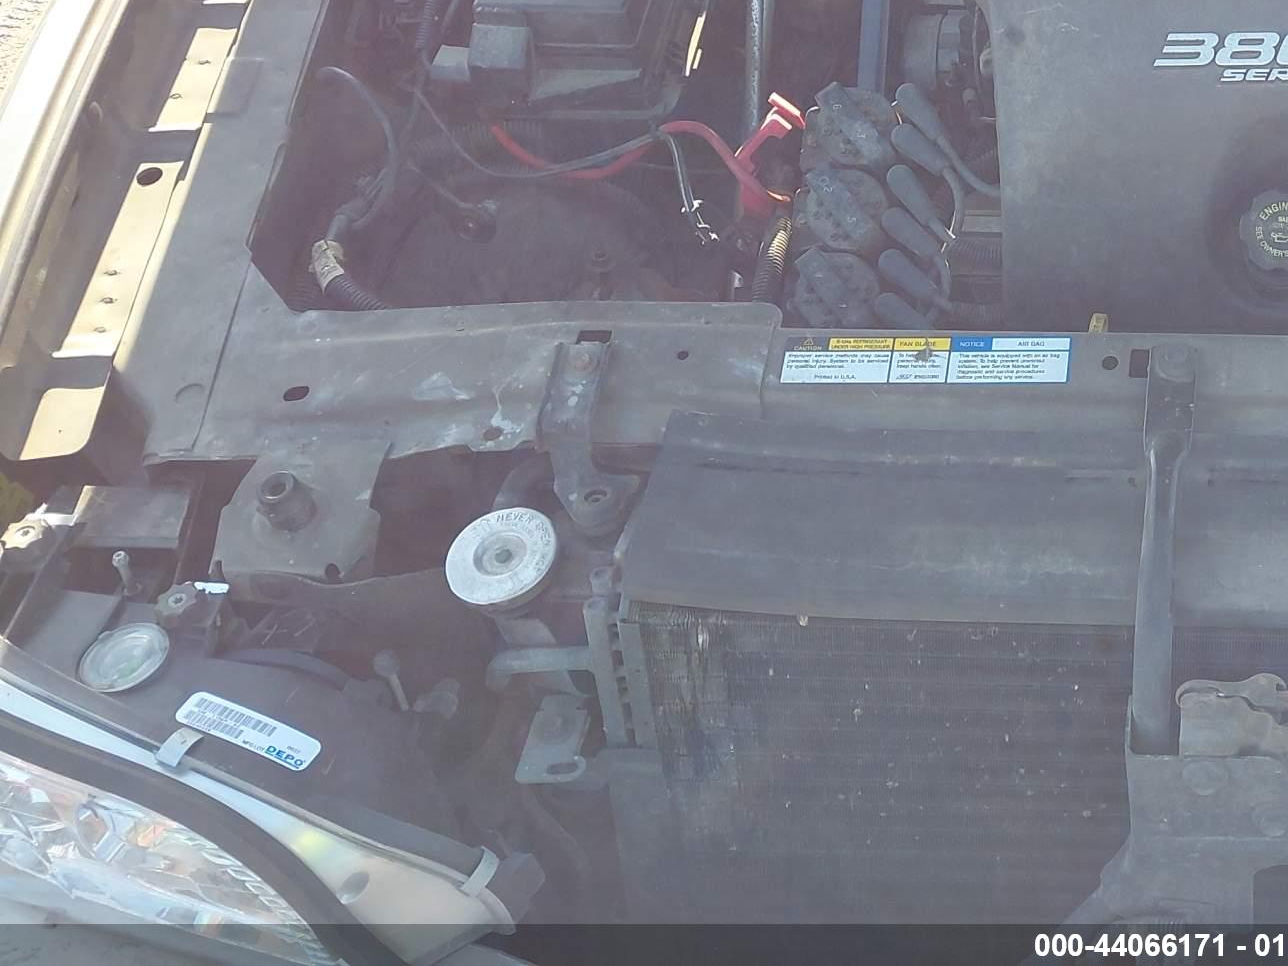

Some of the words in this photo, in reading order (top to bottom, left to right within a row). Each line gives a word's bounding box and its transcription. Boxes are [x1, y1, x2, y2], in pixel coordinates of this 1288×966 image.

[1256, 226, 1264, 240] SEE
[496, 512, 534, 524] NEVER
[266, 745, 305, 767] DEPO
